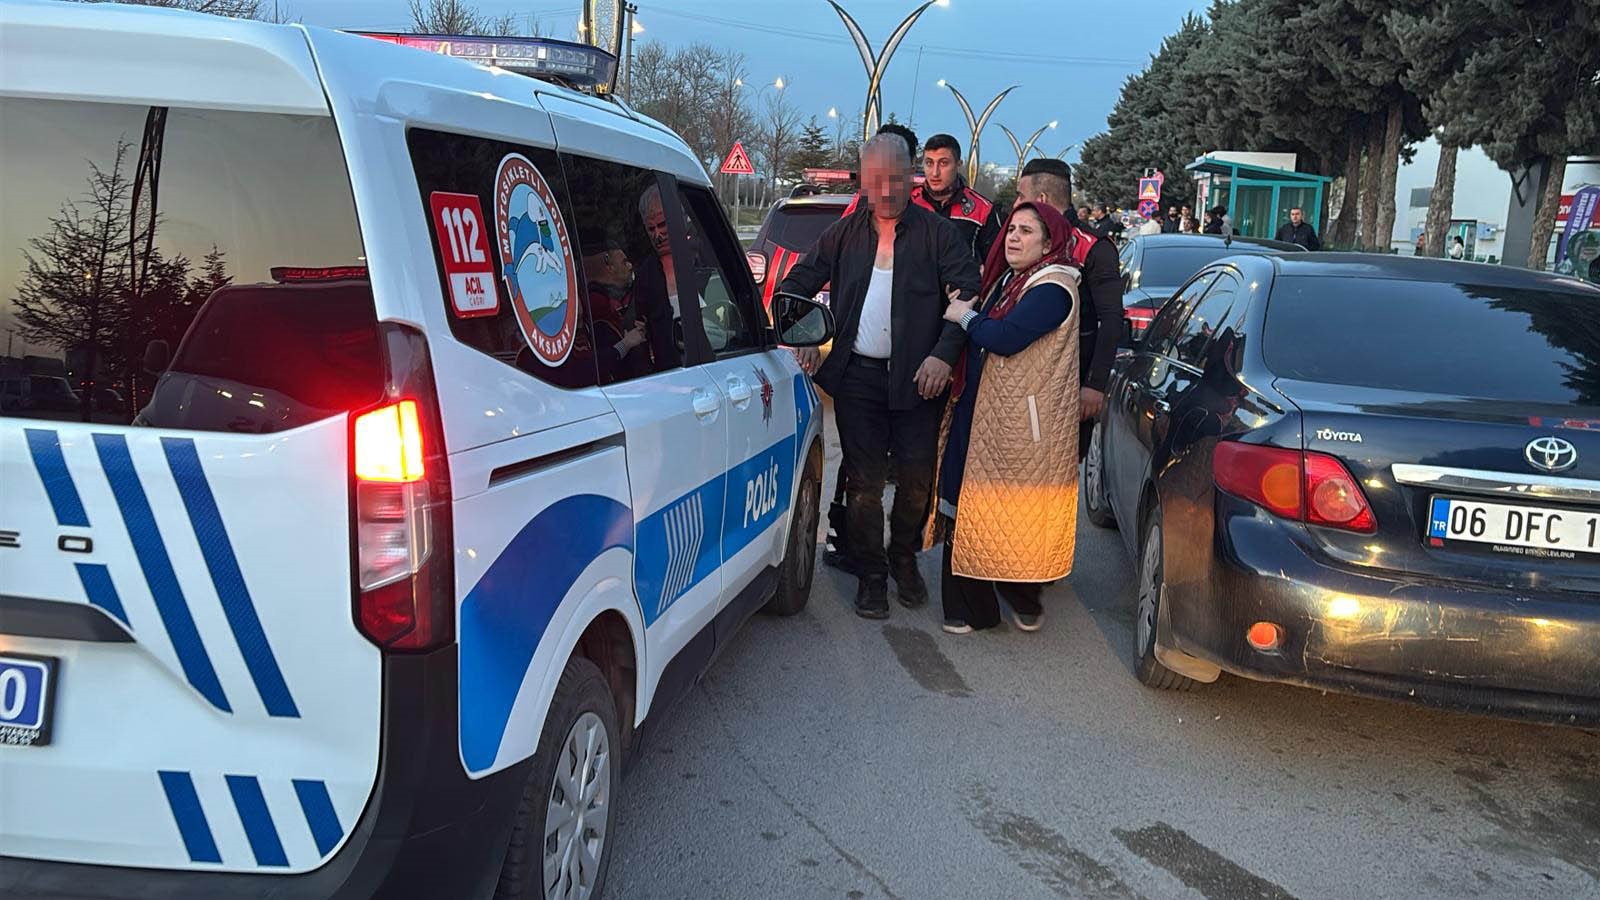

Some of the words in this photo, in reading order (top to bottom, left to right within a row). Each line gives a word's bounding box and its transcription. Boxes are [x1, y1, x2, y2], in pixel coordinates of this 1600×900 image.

[441, 206, 486, 263] 112
[531, 324, 571, 356] AKSARAY
[1316, 428, 1363, 443] TOYOTA
[743, 455, 779, 529] POLİS
[1433, 520, 1446, 531] TR
[1450, 505, 1487, 537] 06
[1505, 510, 1563, 544] DFC
[0, 668, 27, 721] 0
